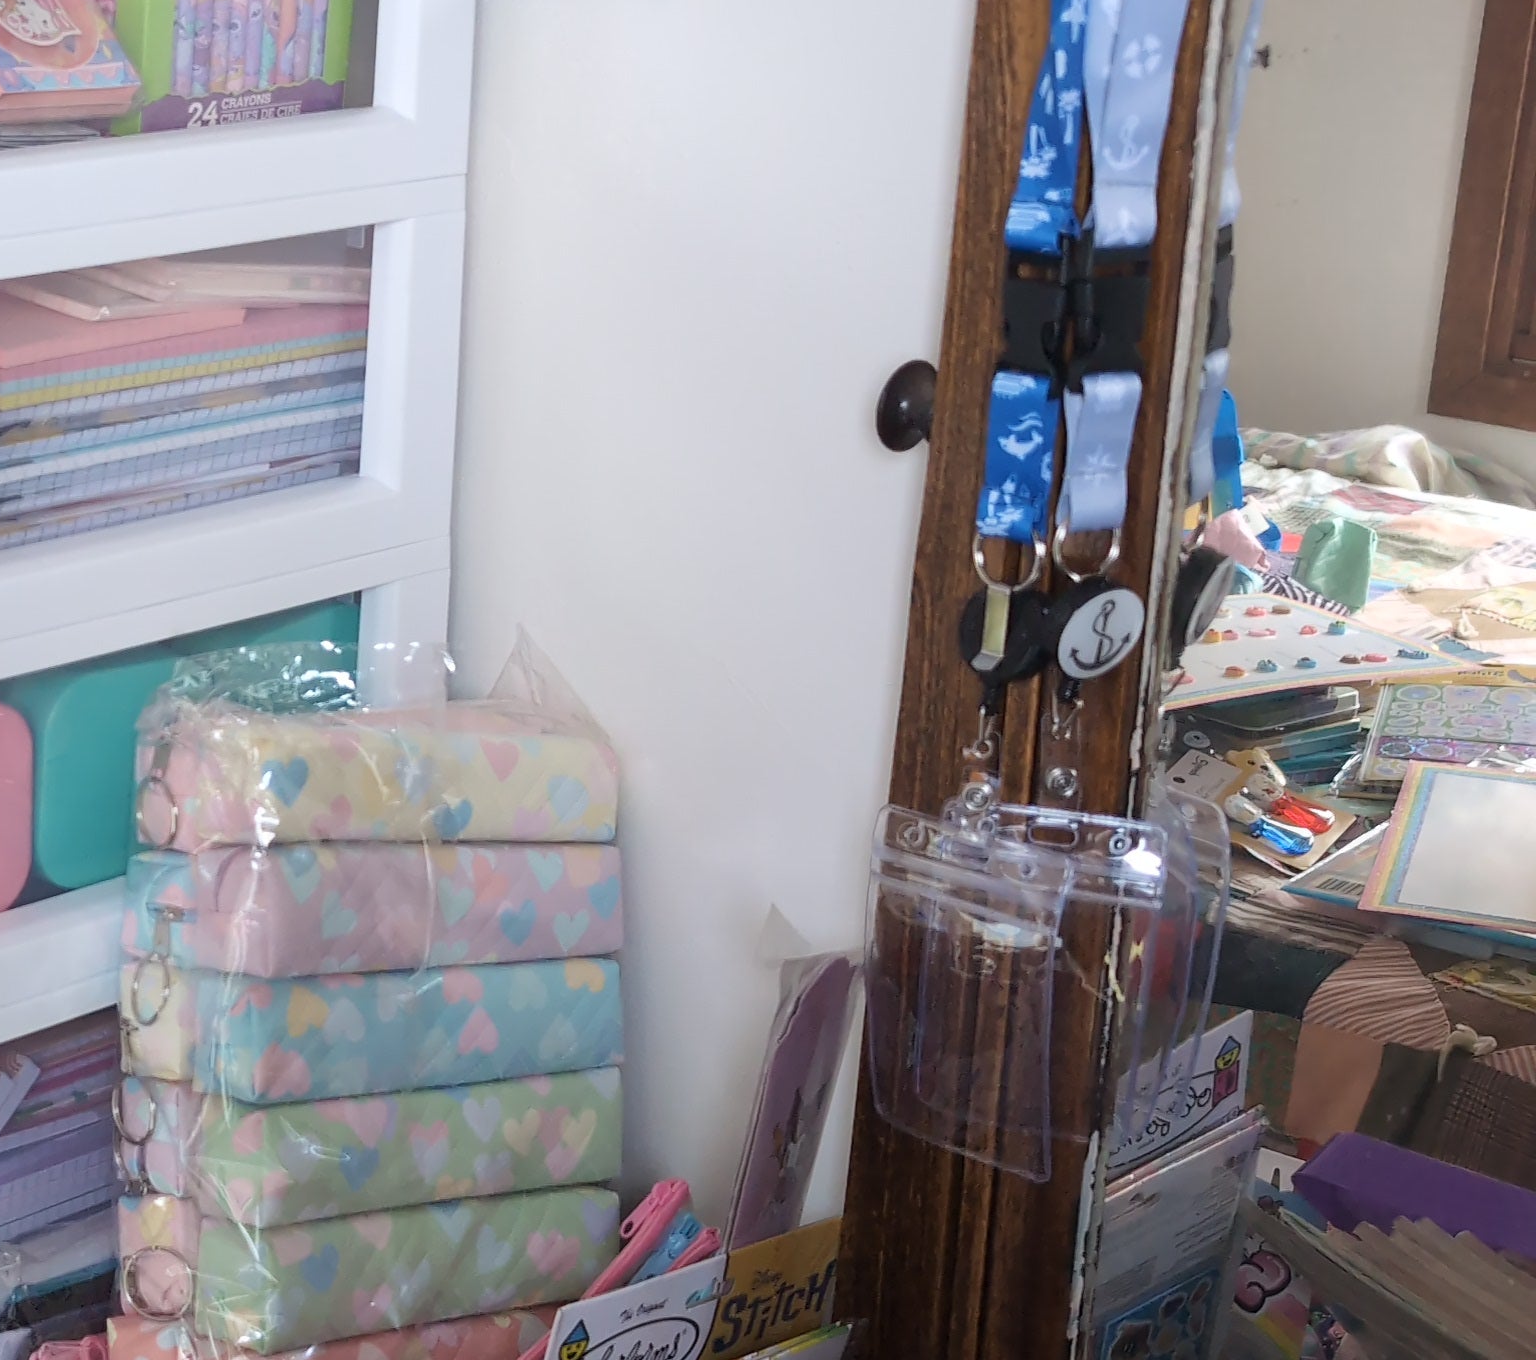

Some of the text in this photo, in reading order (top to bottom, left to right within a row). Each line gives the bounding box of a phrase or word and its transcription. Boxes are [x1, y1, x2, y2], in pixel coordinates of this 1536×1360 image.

[221, 92, 272, 110] CRAYONS
[187, 100, 218, 128] 24
[220, 104, 302, 125] CRAIES DE CIRE
